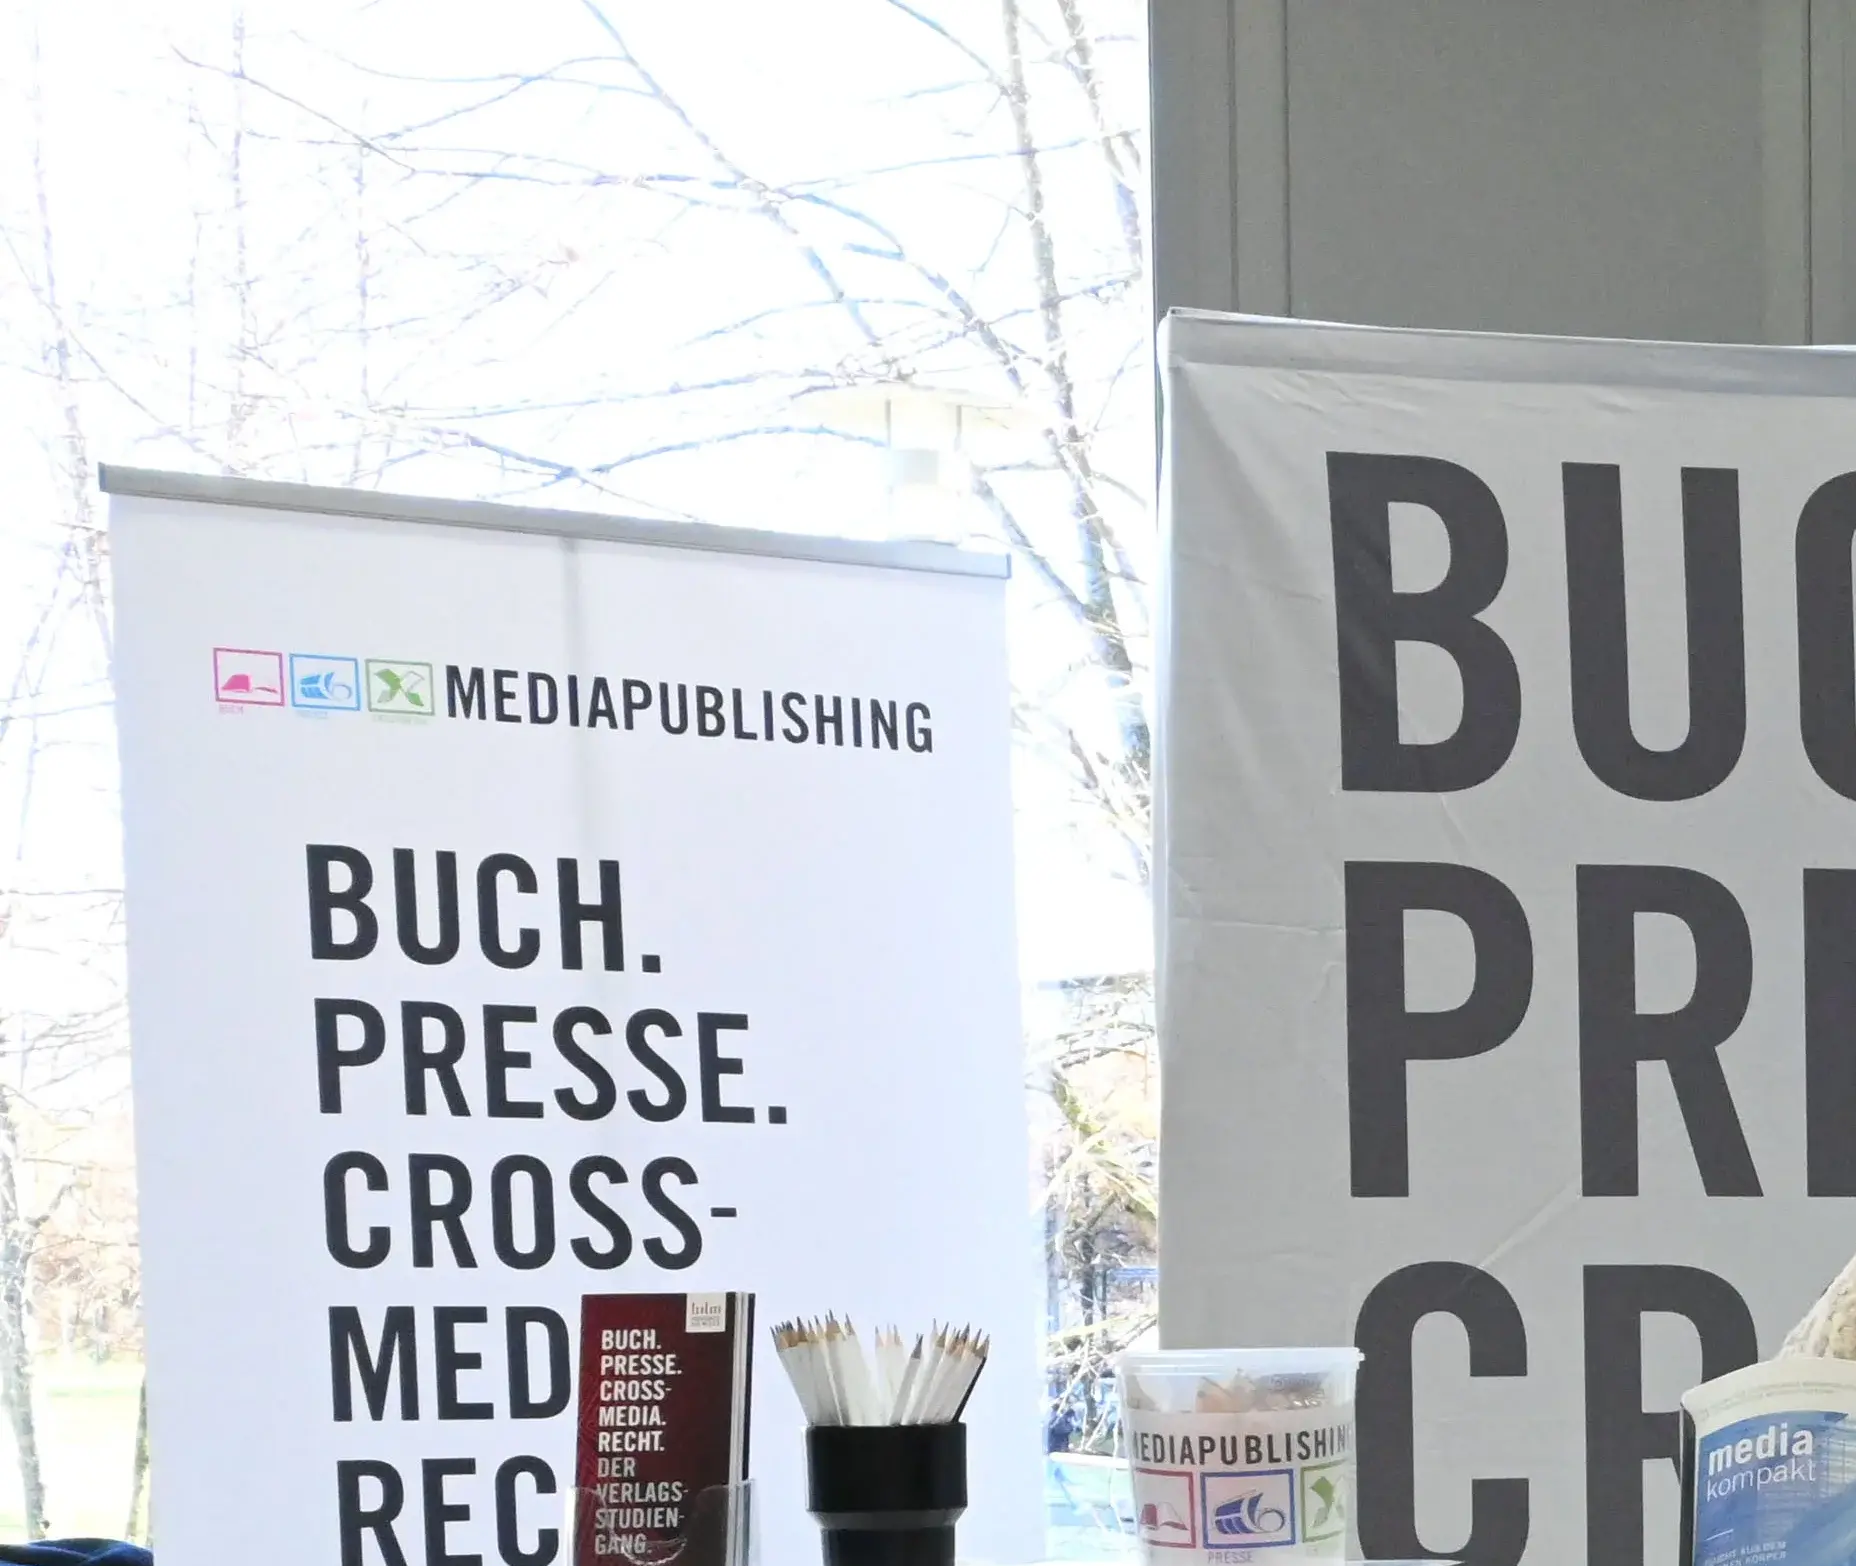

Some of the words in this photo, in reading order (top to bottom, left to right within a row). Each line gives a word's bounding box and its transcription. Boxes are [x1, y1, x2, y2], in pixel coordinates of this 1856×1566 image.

[445, 664, 934, 754] MEDIAPUBLISHING
[305, 843, 662, 974] BUCH.
[313, 997, 788, 1126] PRESSE.
[322, 1150, 738, 1271] CROSS-
[601, 1329, 662, 1350] BUCH.
[328, 1305, 572, 1422] MED
[600, 1354, 682, 1376] PRESSE.
[599, 1379, 672, 1401] CROSS-
[598, 1405, 667, 1427] MEDIA.
[598, 1431, 665, 1452] RECHT.
[1708, 1423, 1815, 1475] media
[597, 1457, 636, 1478] DER
[1706, 1457, 1816, 1502] kompakt
[596, 1481, 688, 1503] VERLAGS-
[595, 1507, 685, 1529] STUDIEN-
[594, 1534, 652, 1556] GANG.
